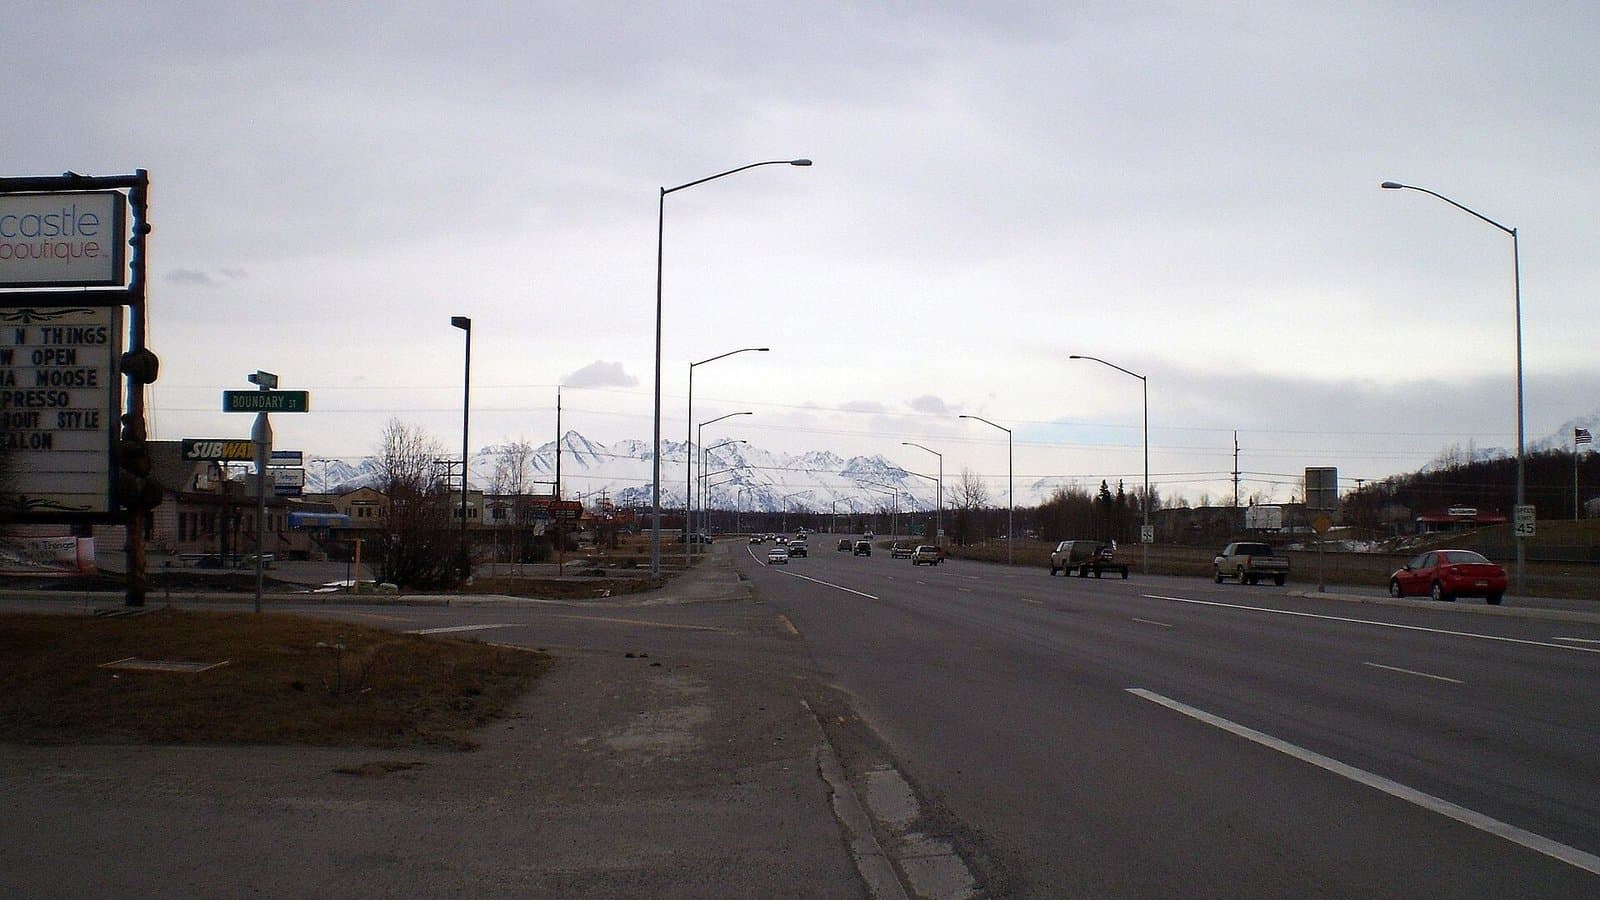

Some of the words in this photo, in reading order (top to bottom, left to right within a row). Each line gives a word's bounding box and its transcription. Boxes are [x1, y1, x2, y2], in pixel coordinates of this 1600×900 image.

[0, 204, 99, 238] castle
[41, 327, 107, 345] THINGS
[32, 348, 76, 366] OPEN
[36, 369, 97, 387] MOOSE
[2, 390, 69, 408] PRESSO
[232, 395, 284, 408] BOUNDARY
[57, 411, 99, 428] STYLE
[1517, 523, 1534, 534] 45
